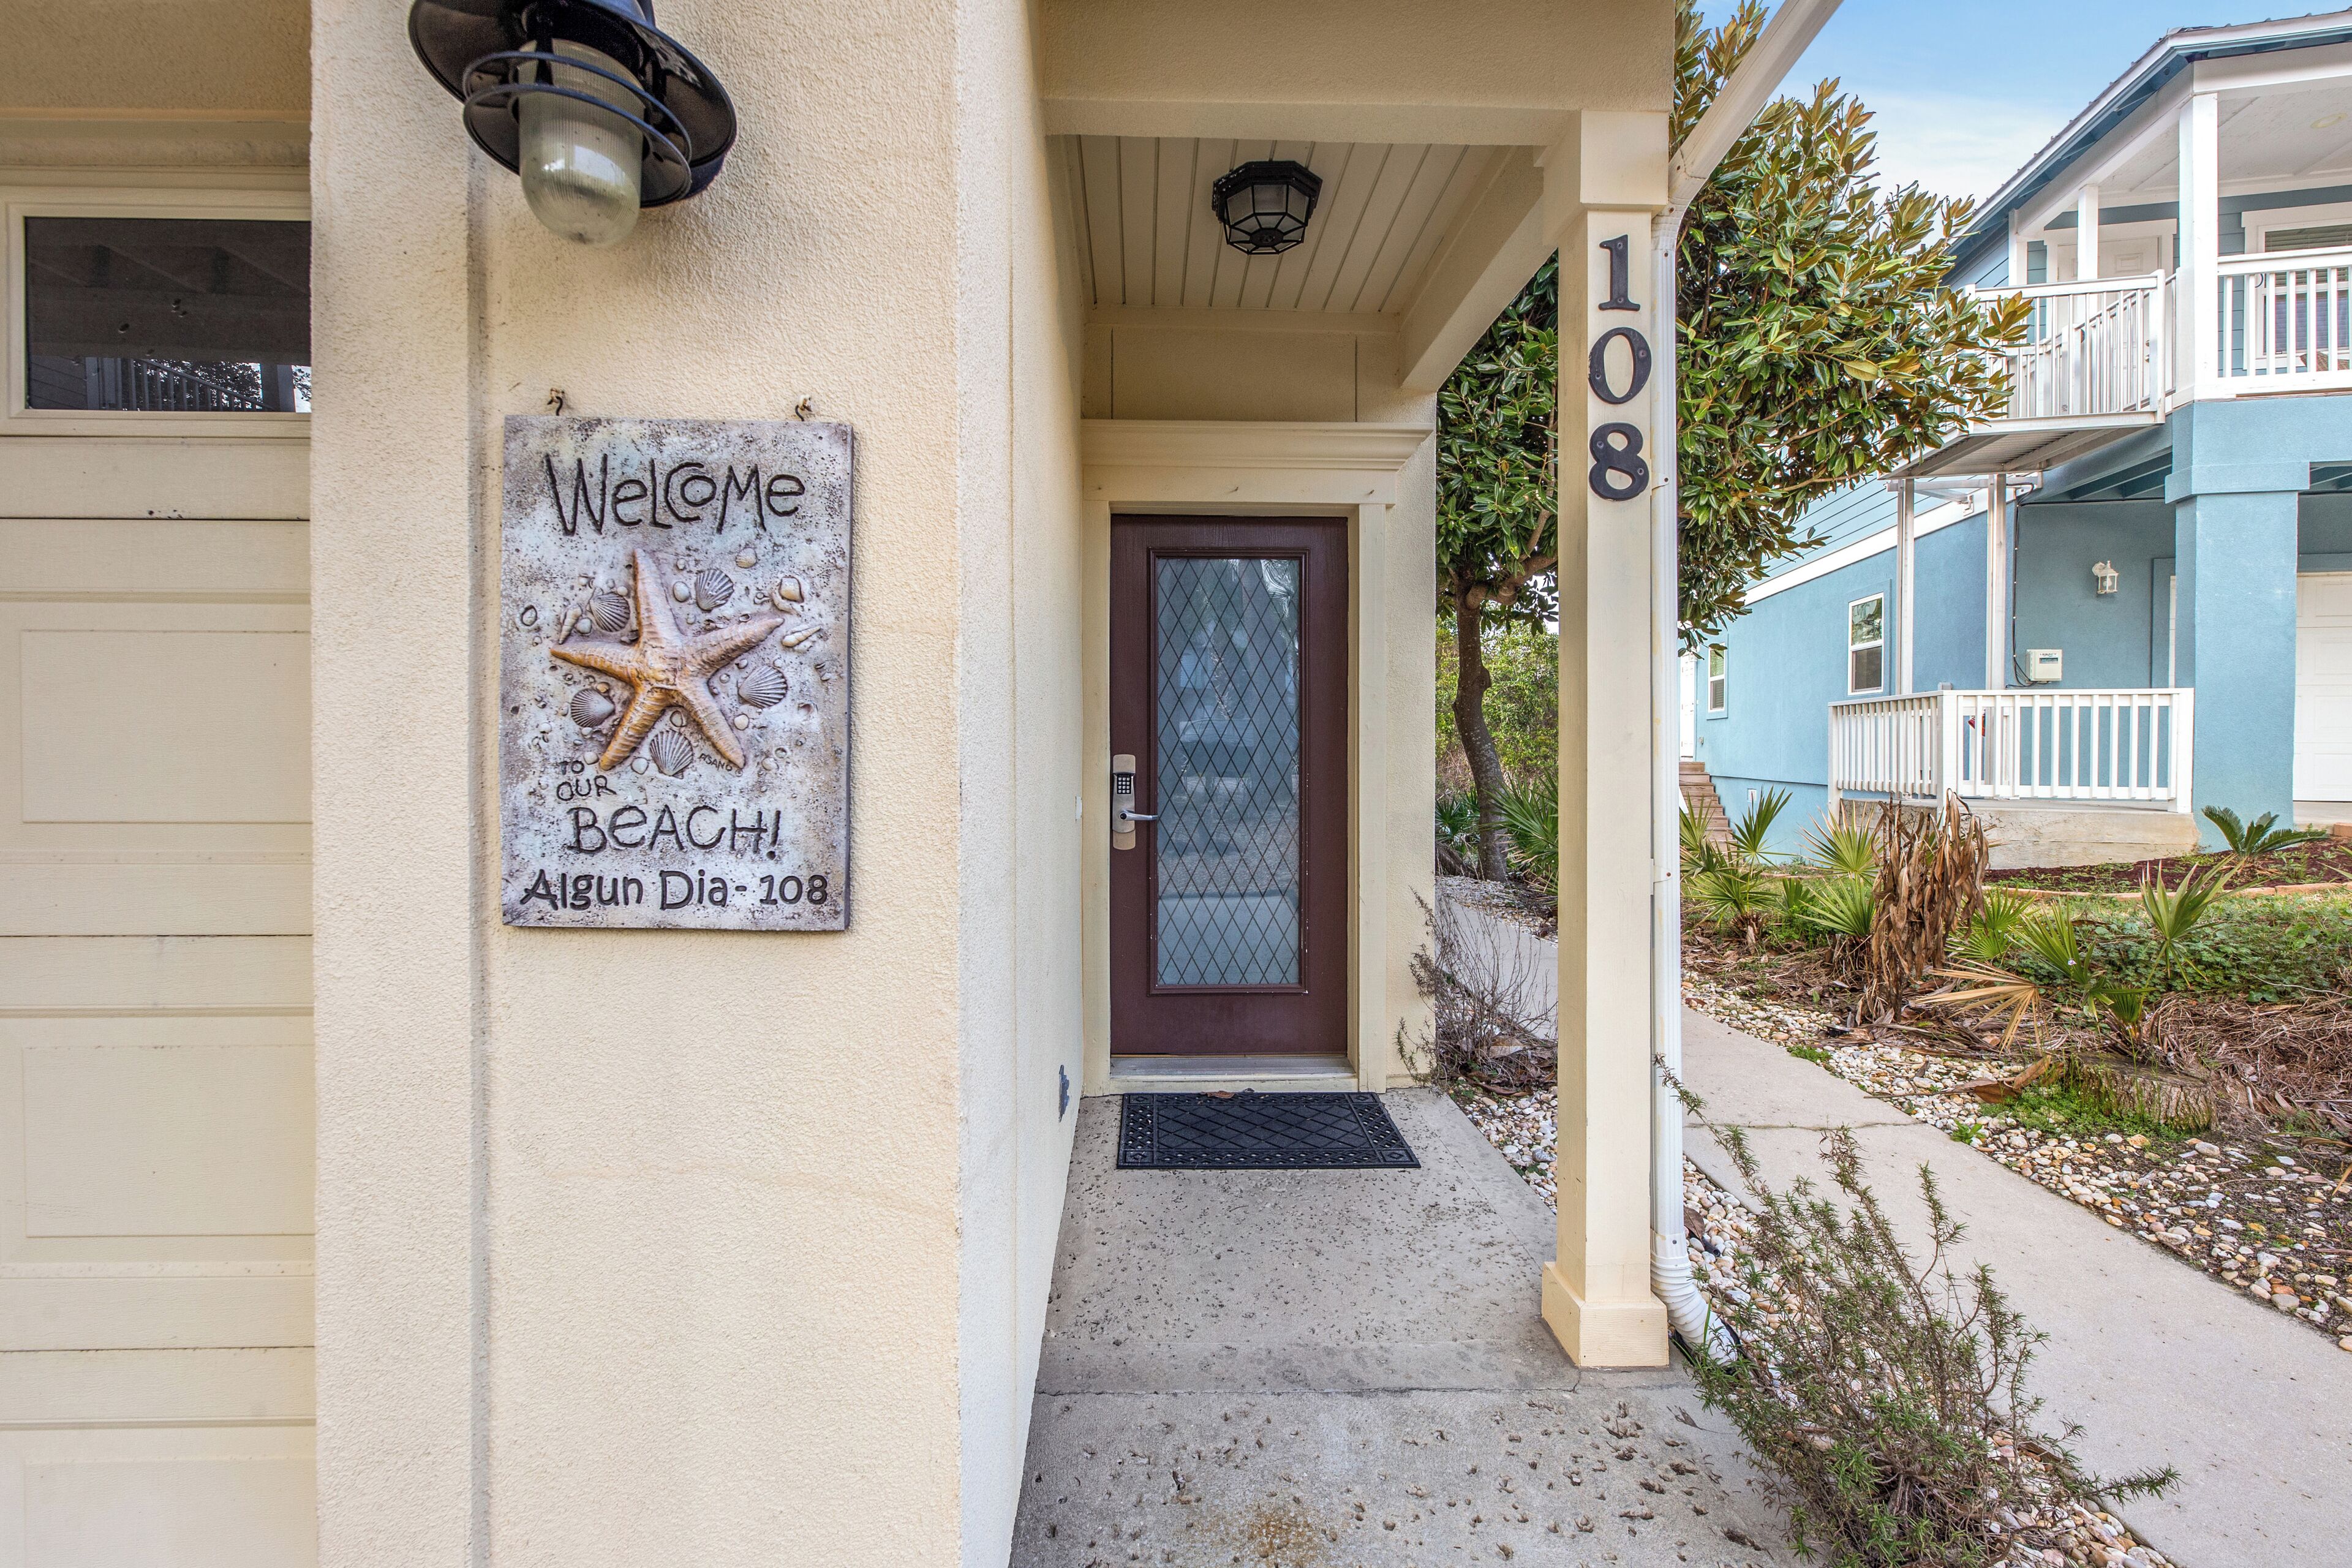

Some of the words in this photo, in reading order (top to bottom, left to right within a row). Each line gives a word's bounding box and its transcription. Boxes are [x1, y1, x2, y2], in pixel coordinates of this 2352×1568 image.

[1588, 234, 1652, 502] 108
[560, 760, 585, 775] TO
[556, 774, 617, 802] OUR
[520, 869, 644, 911] Algun
